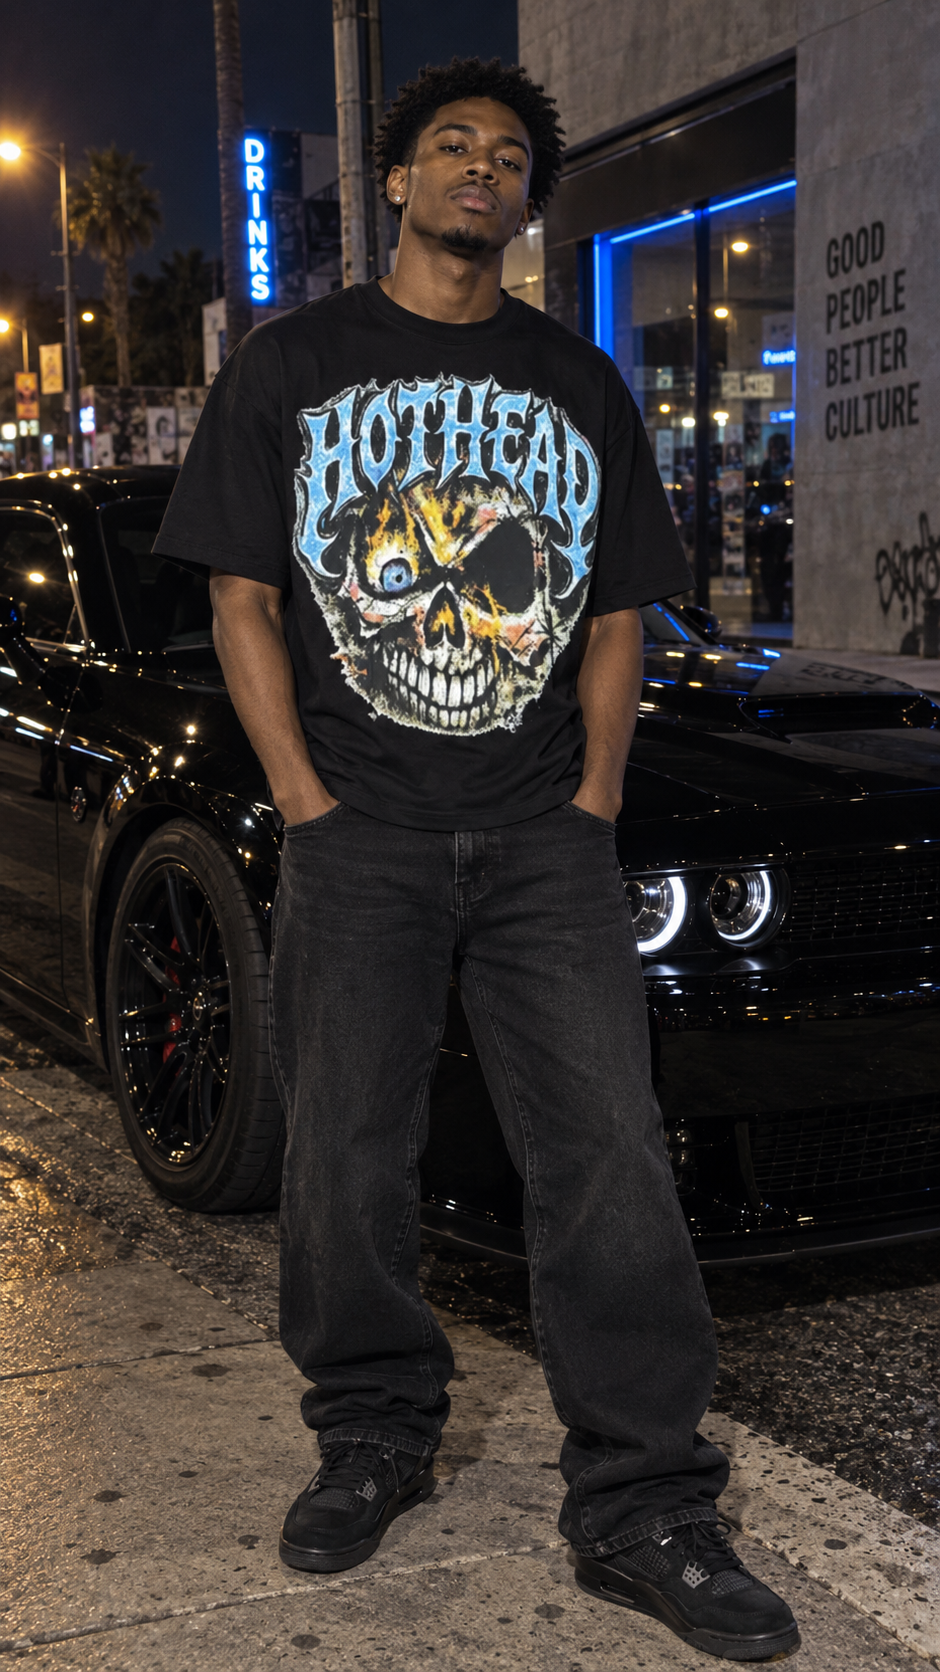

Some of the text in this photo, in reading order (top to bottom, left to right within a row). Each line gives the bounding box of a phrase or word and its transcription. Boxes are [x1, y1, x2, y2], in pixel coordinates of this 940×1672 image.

[244, 138, 270, 300] DRINKS
[826, 220, 885, 279] GOOD
[826, 268, 906, 335] PEOPLE
[826, 327, 907, 388] BETTER
[825, 381, 920, 442] CULTURE
[298, 374, 601, 600] HOTHEAD
